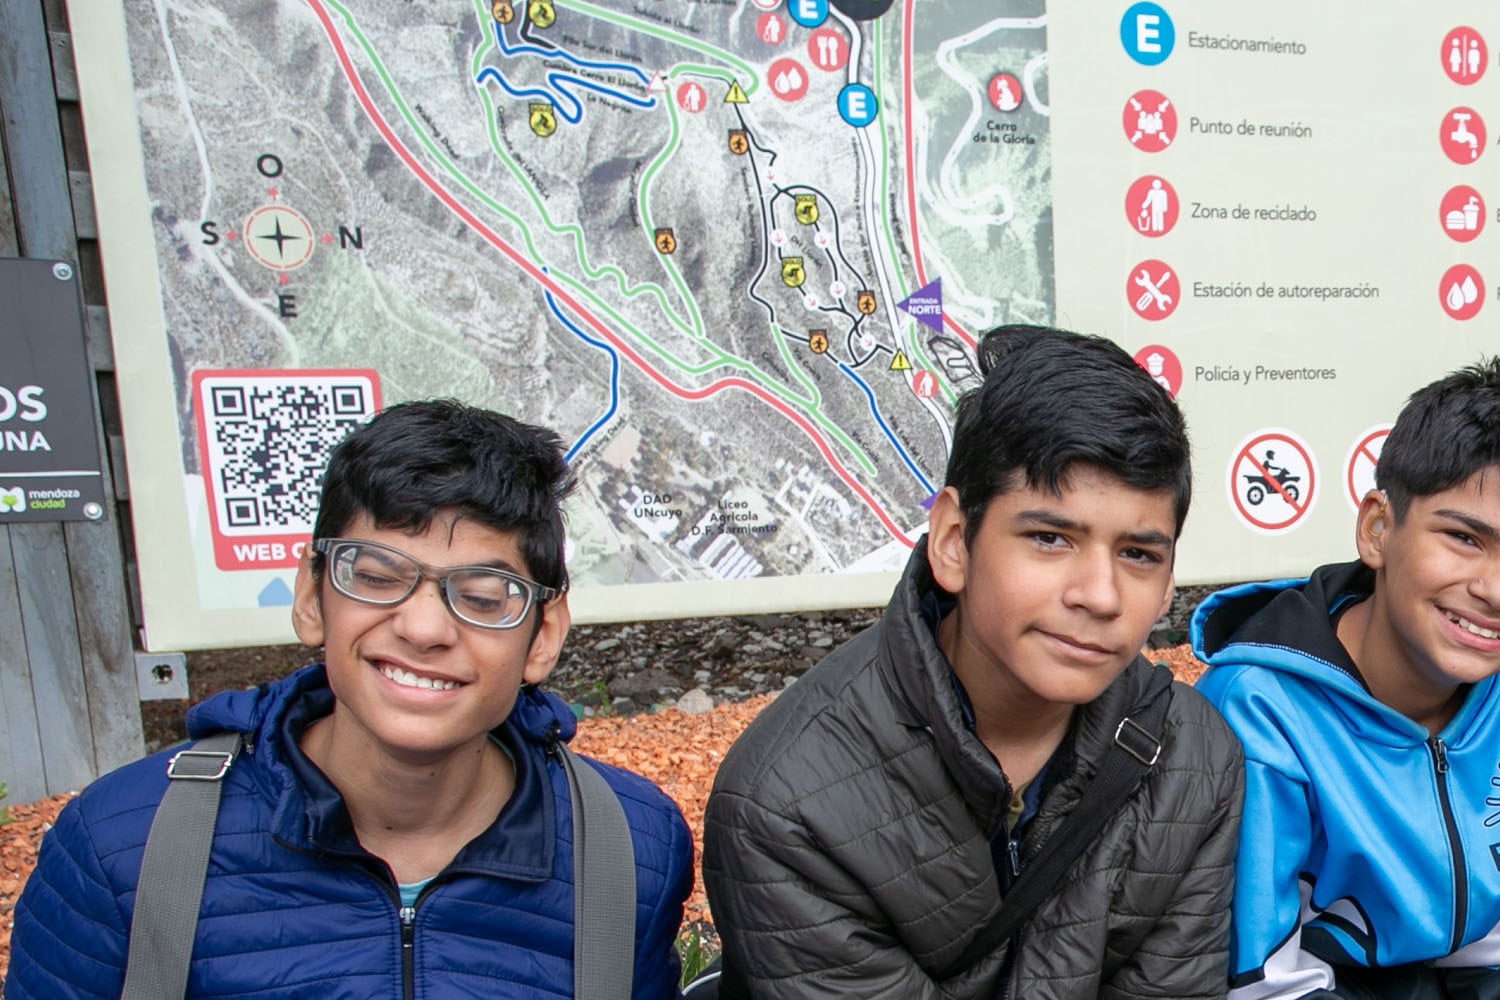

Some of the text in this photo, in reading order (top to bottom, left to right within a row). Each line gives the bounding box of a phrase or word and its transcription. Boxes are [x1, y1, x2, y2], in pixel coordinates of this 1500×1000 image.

[1137, 14, 1307, 55] E Estacionamiento
[848, 91, 867, 118] E
[986, 120, 1017, 132] Cerro
[1189, 116, 1313, 139] Punto de reunión
[973, 132, 1036, 145] de la Gloria
[257, 154, 283, 178] O
[1191, 202, 1317, 221] Zona de reciclado
[201, 221, 220, 245] S
[339, 225, 363, 249] N
[1193, 281, 1380, 302] Estación de autoreparación
[279, 295, 298, 318] E
[908, 305, 941, 315] NORTE
[1195, 364, 1337, 386] Policía y Preventores
[0, 431, 52, 451] NA
[29, 488, 80, 499] mendoza
[643, 494, 673, 505] DAD
[30, 499, 66, 509] ciudad
[717, 500, 749, 510] Liceo
[634, 508, 683, 521] UNcuyo
[691, 524, 778, 536] D.F. Sarmiento
[233, 543, 286, 562] WEB
